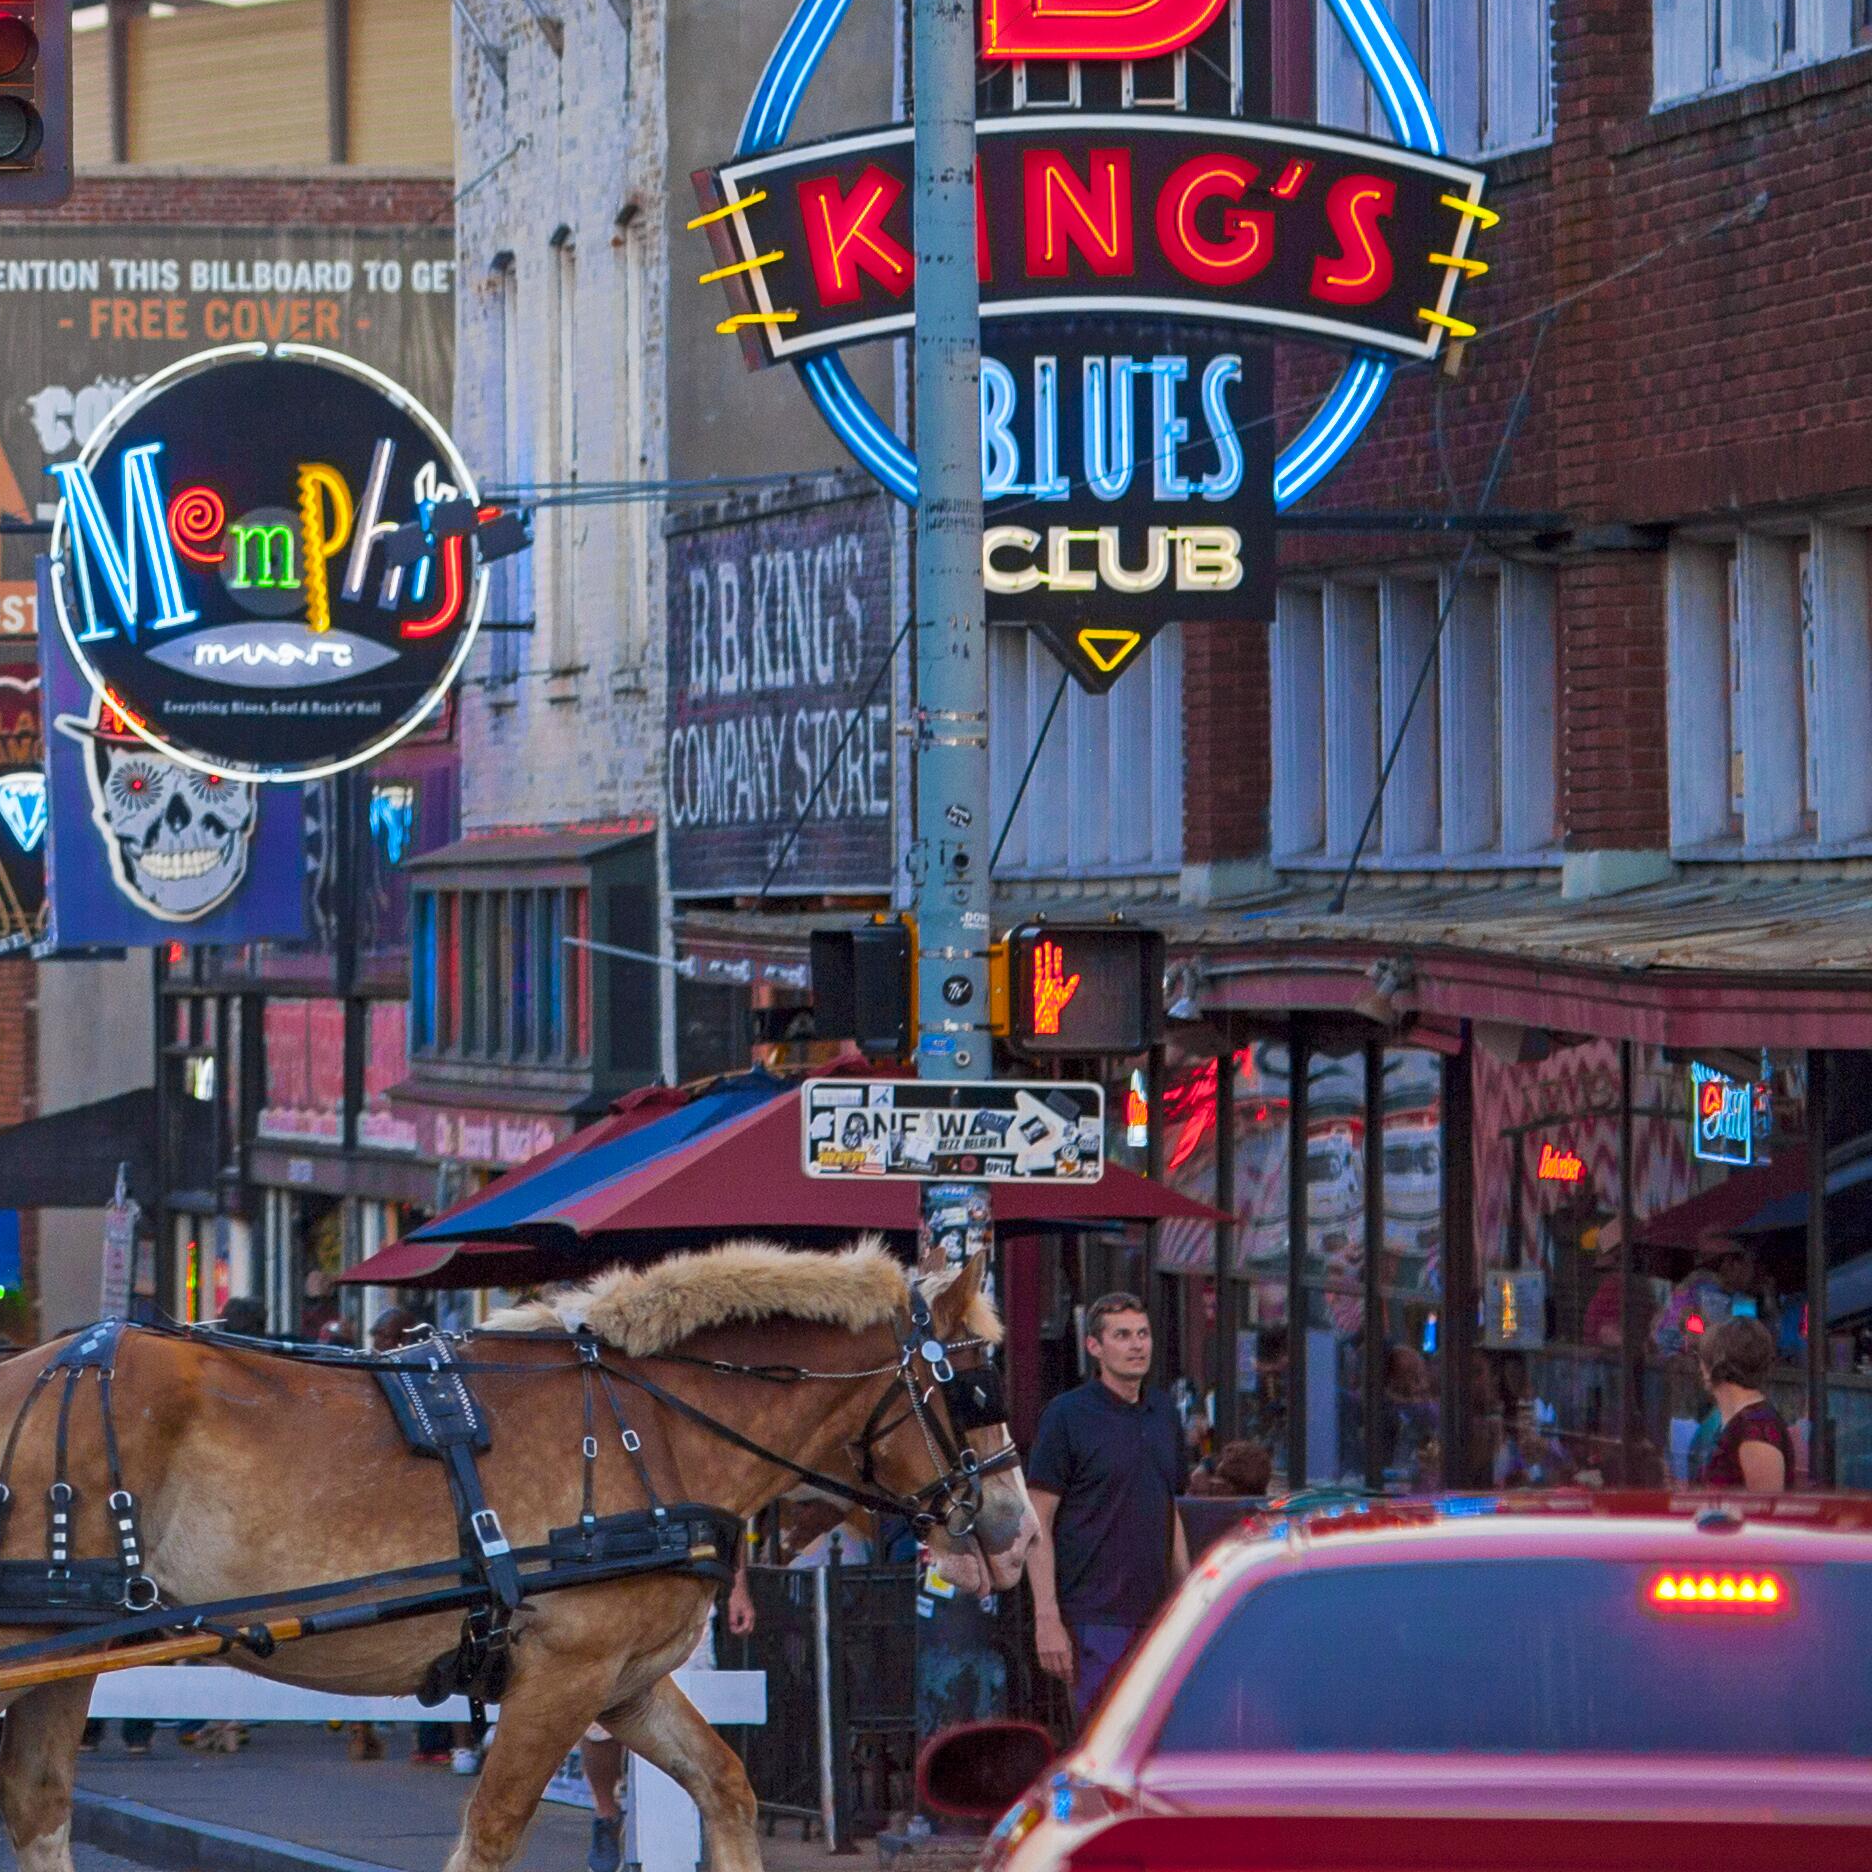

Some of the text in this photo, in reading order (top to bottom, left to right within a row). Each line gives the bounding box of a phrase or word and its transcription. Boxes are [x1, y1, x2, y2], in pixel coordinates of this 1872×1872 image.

[109, 259, 180, 293] THIS
[189, 259, 353, 293] BILLBOARD
[362, 260, 402, 293] TO
[411, 260, 456, 294] GE
[89, 297, 341, 341] FREE COVER
[980, 354, 1244, 503] BLUES
[983, 525, 1245, 595] CLUB
[194, 641, 354, 668] music
[162, 699, 229, 716] Everything
[669, 704, 889, 828] COMPANY STORE
